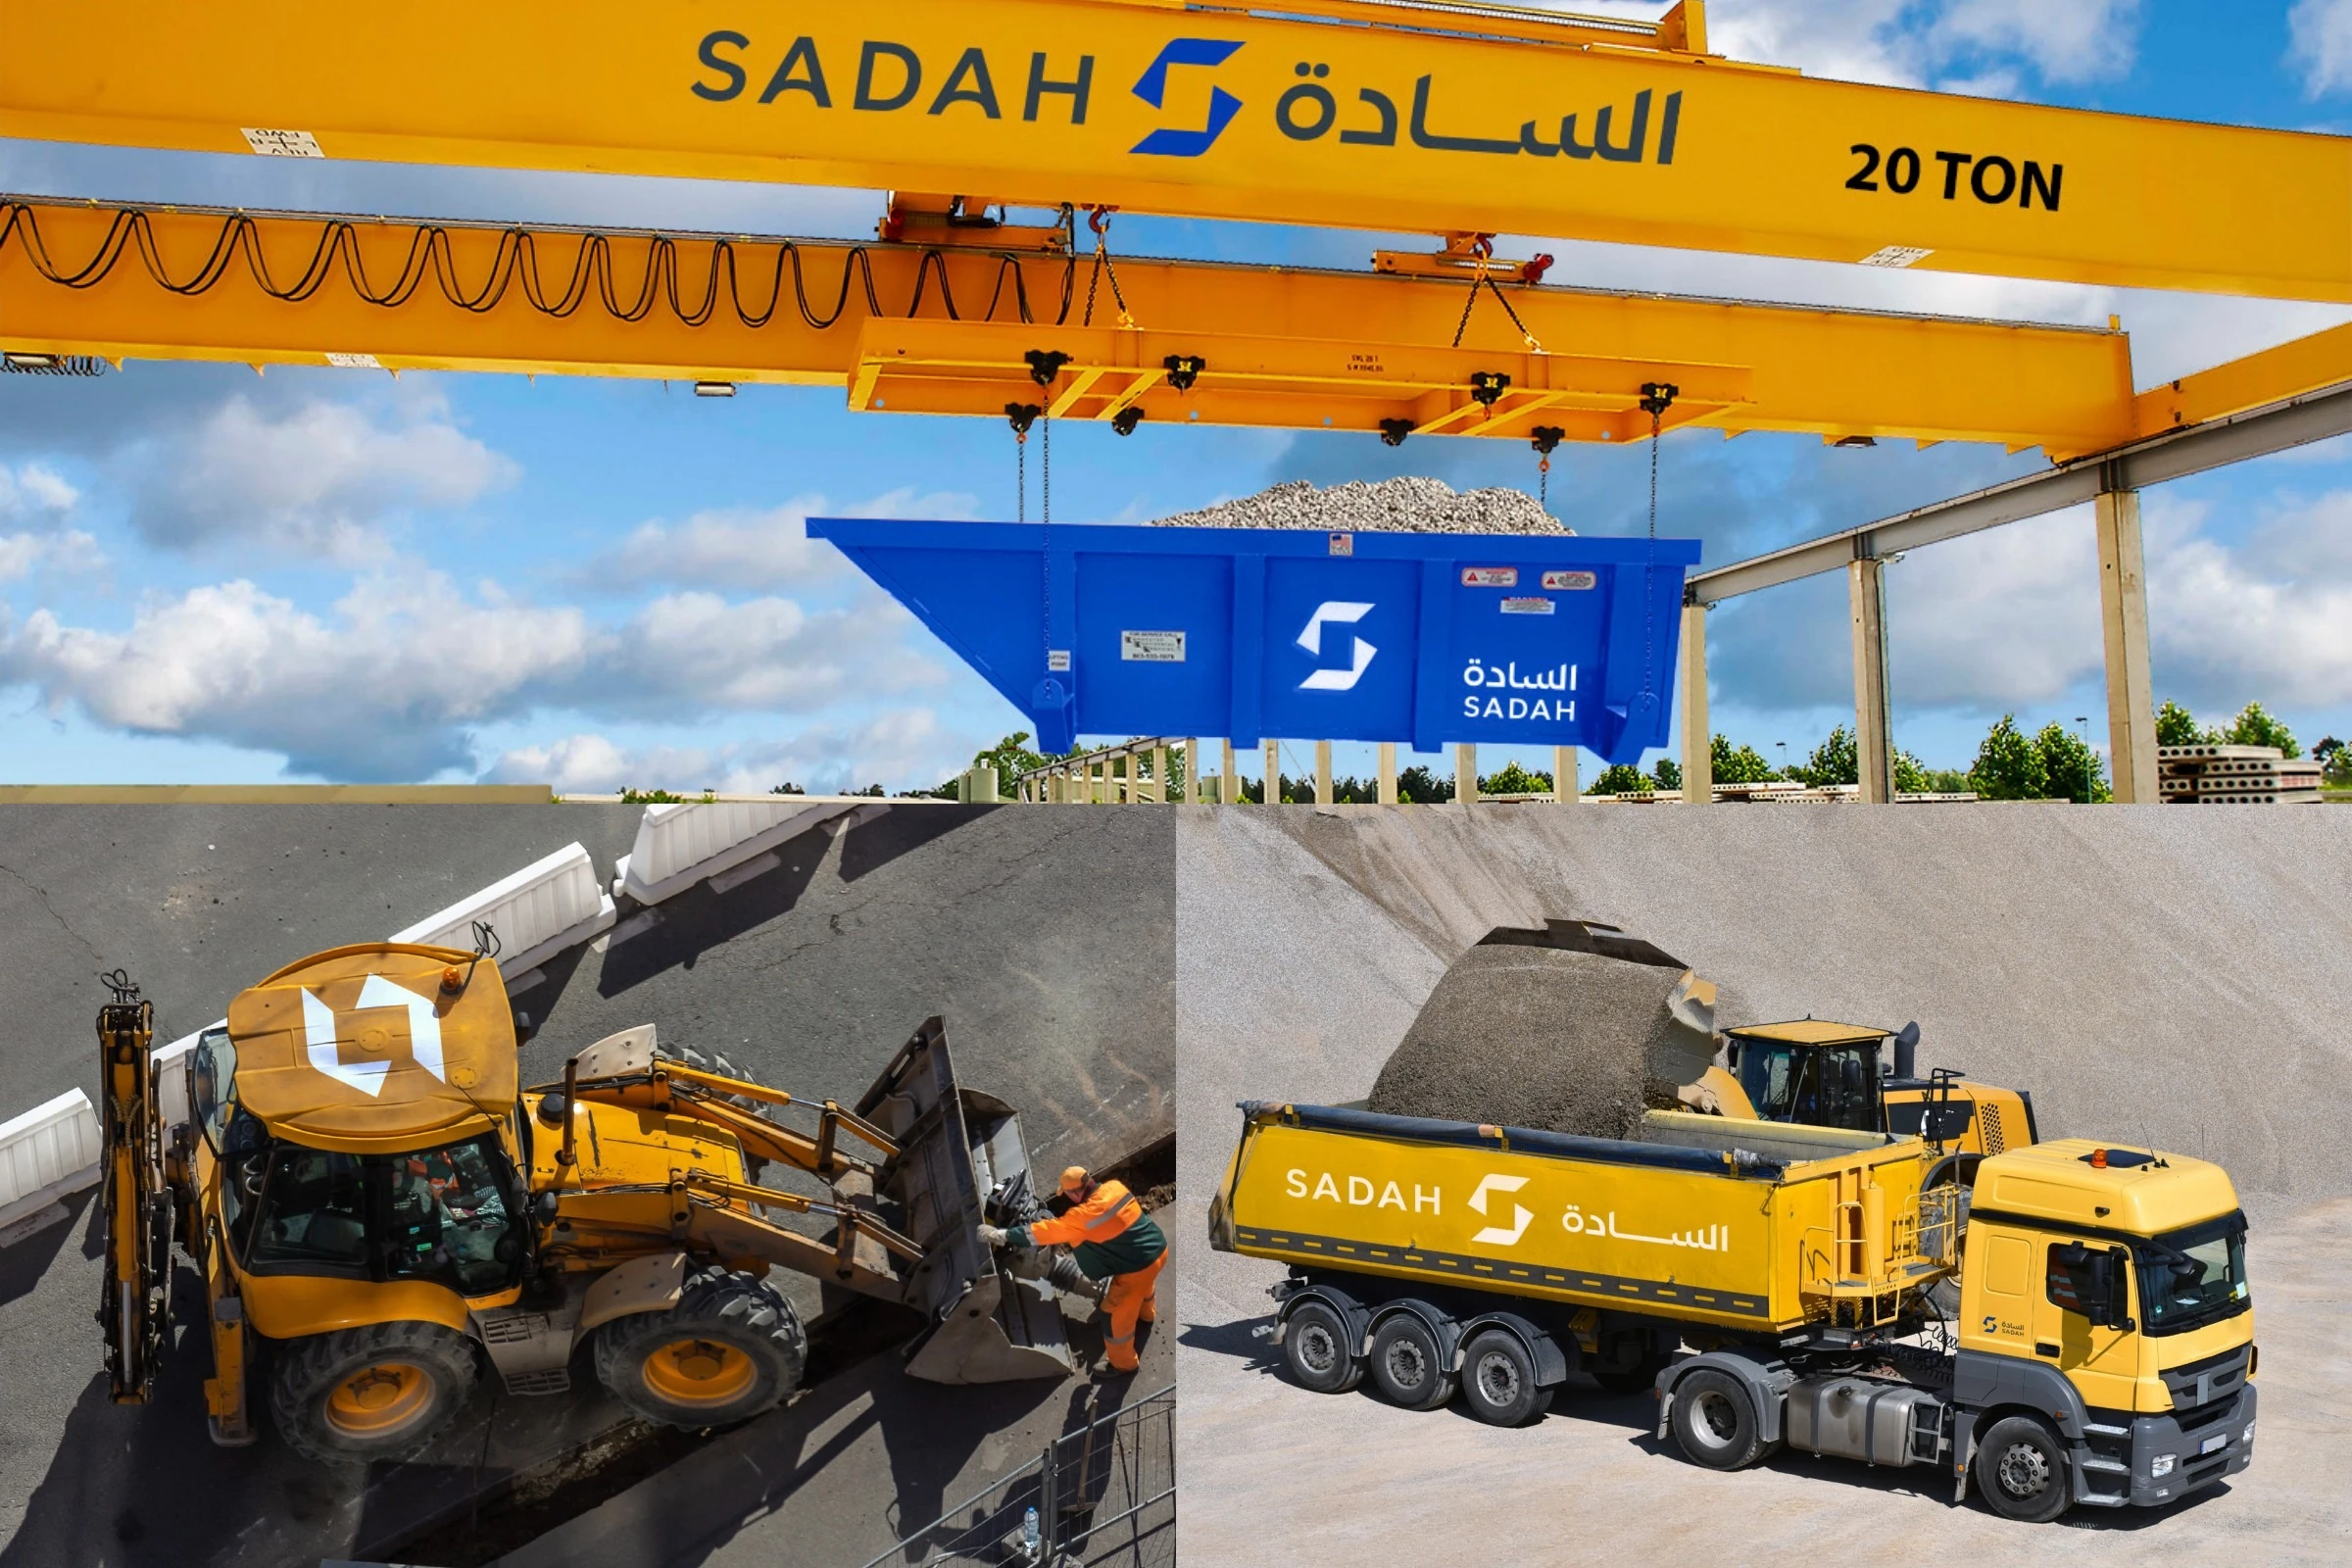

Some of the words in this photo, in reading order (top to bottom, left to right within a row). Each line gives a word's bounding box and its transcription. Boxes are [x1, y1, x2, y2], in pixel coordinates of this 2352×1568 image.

[692, 29, 1095, 125] SADAH
[1844, 144, 1921, 195] 20
[1936, 151, 2064, 213] TON
[1463, 659, 1577, 691] السادة
[1463, 696, 1575, 721] SADAH
[1286, 1169, 1441, 1215] SADAH
